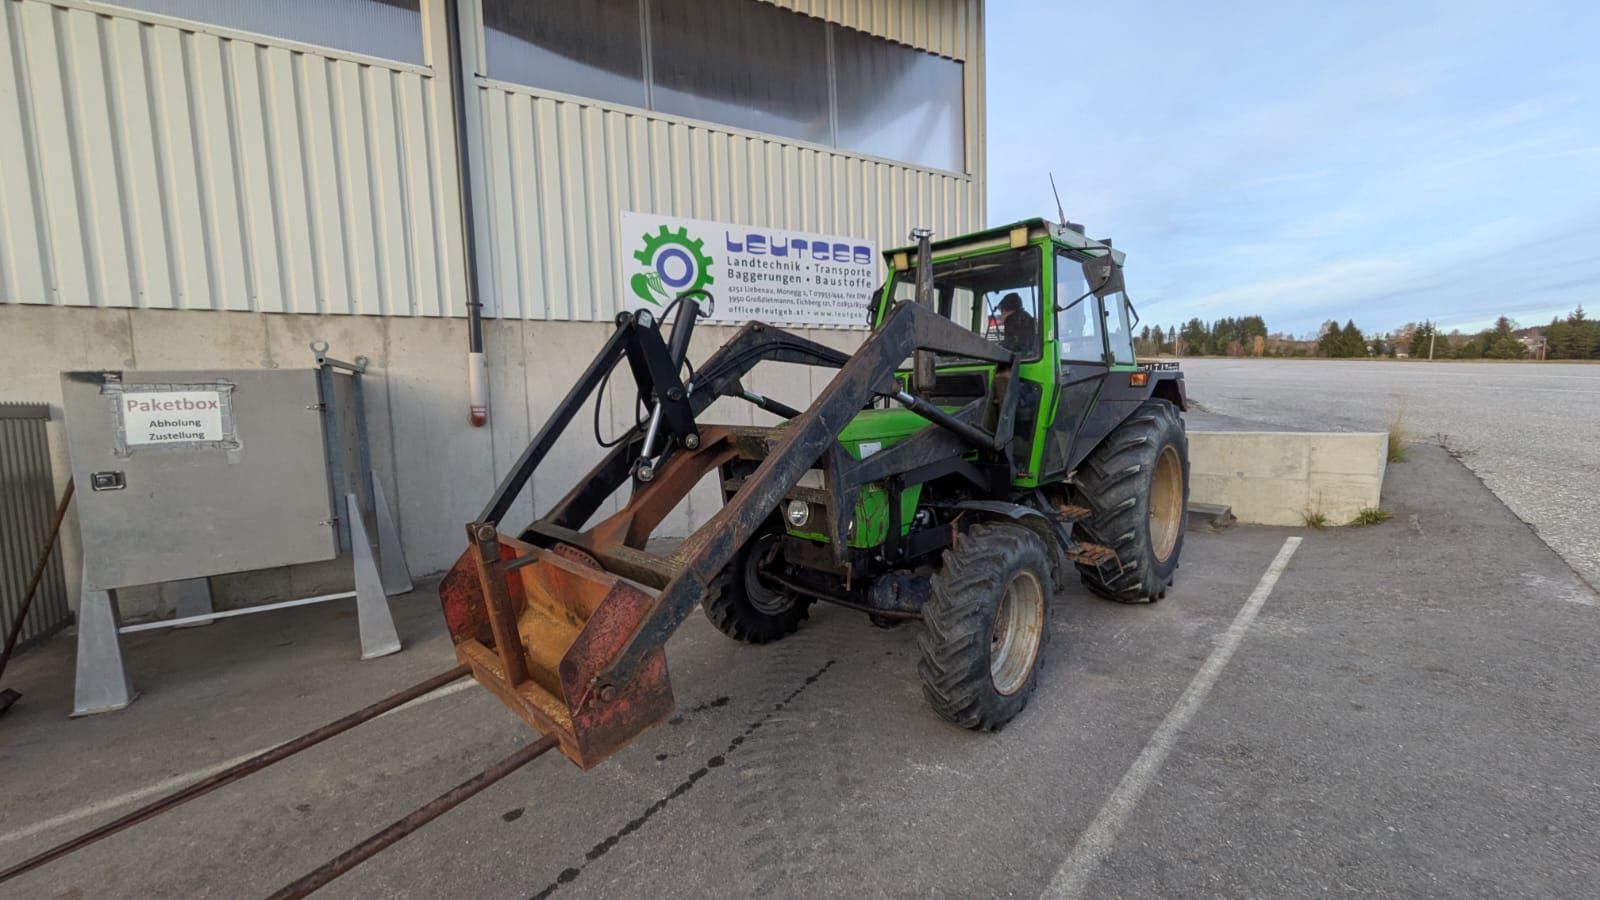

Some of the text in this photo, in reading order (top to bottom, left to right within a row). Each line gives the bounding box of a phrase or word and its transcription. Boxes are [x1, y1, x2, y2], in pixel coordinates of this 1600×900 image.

[726, 231, 871, 265] LEUTGEB
[727, 256, 871, 277] Landtechnik Transporte
[728, 268, 871, 288] Baggerungen Baustoffe
[127, 397, 218, 412] Paketbox
[149, 418, 202, 428] Abholung
[148, 432, 205, 440] Zustellung
